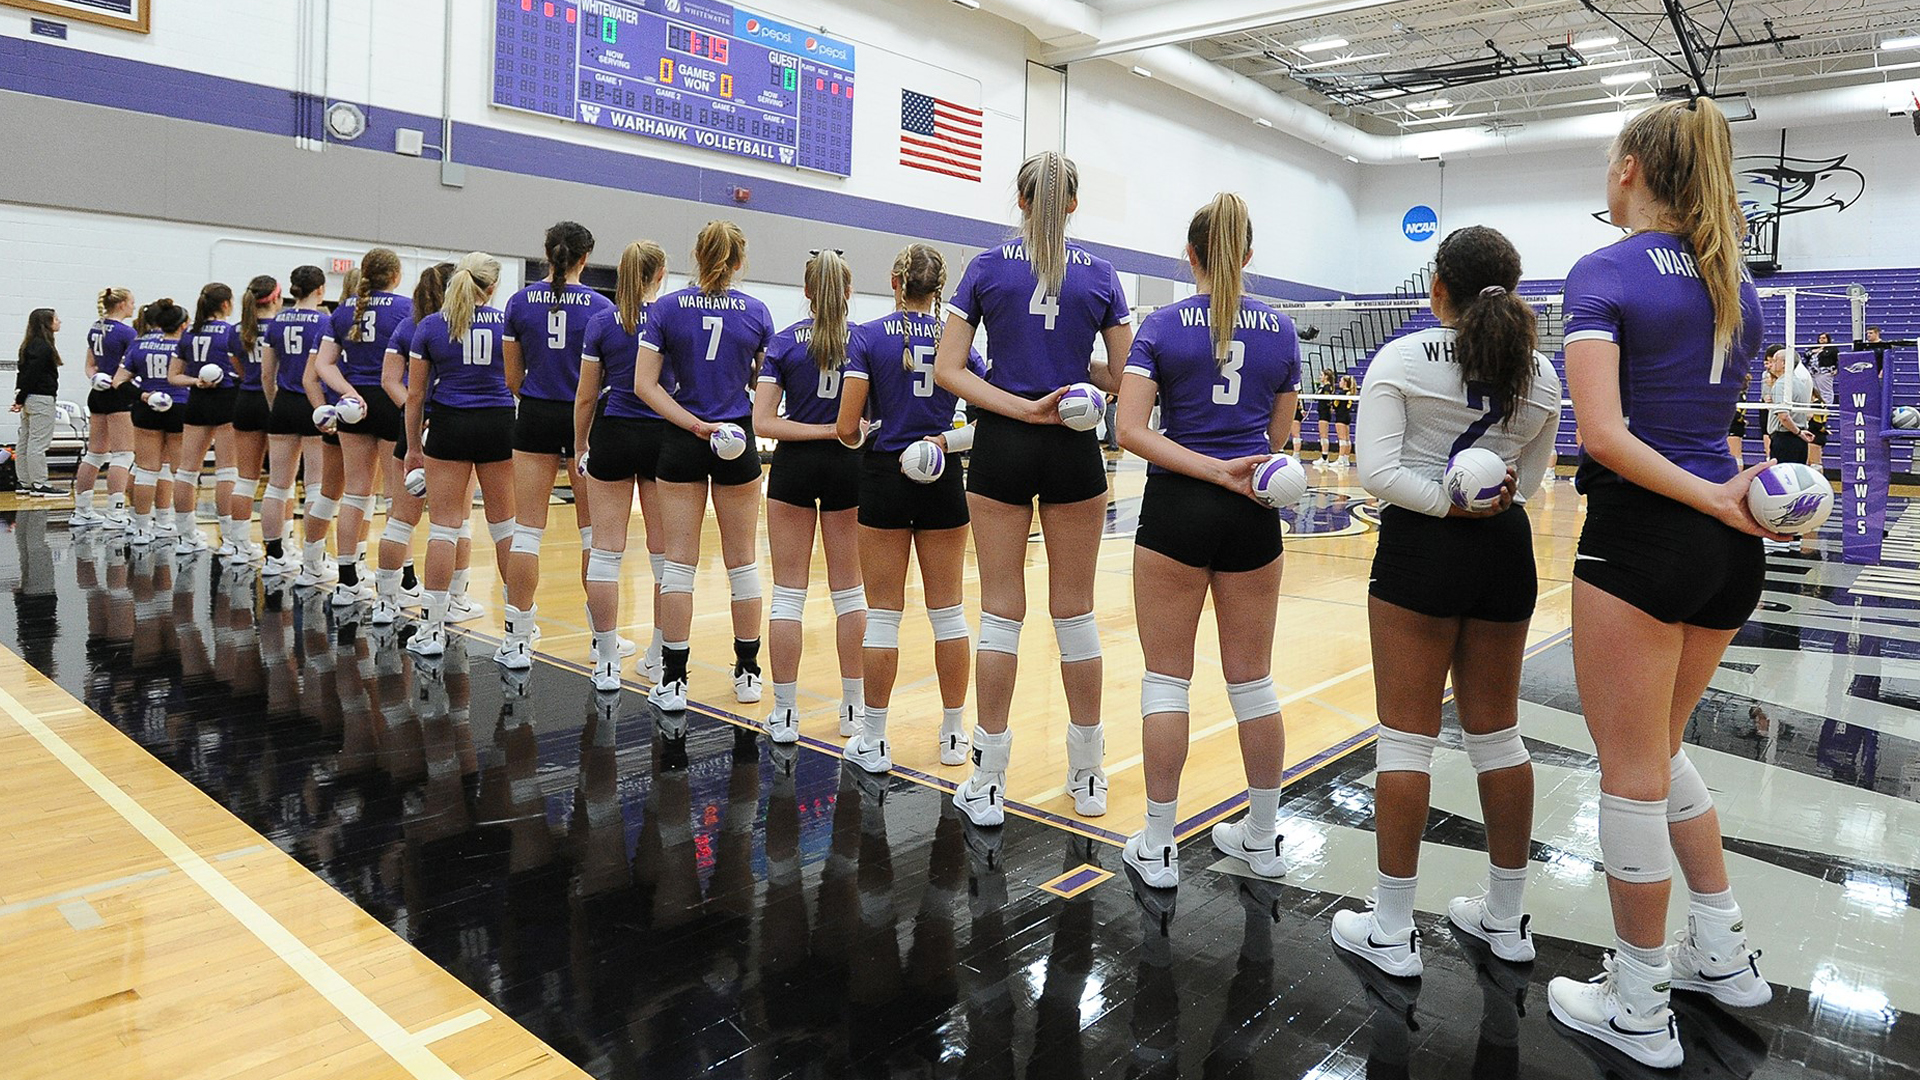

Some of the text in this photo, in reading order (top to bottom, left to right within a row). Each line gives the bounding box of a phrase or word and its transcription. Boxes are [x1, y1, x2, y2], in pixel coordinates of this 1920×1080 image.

[581, 0, 638, 26] WHITEWATER
[683, 6, 730, 25] WHITEWATER
[602, 16, 617, 44] 0
[761, 27, 791, 43] pepsi
[605, 49, 624, 59] NOW
[768, 51, 798, 69] GUEST
[818, 45, 847, 60] pepsi
[598, 55, 631, 70] SERVING
[660, 57, 674, 84] 0
[595, 73, 623, 86] GAME 1
[678, 64, 716, 82] GAMES
[784, 67, 797, 91] 0
[683, 77, 709, 92] WON
[720, 73, 733, 98] 0
[655, 88, 682, 101] GAME 2
[757, 95, 784, 108] SERVING
[763, 89, 779, 99] NOW
[712, 101, 731, 112] GAME
[762, 113, 780, 123] GAME
[610, 111, 775, 159] WARHAWK VOLLEYBALL
[1405, 222, 1436, 234] NCAA
[1003, 244, 1092, 266] WAKS
[332, 259, 353, 273] EXIT
[345, 296, 394, 307] WAAWKS
[678, 295, 746, 311] WARHAWKS
[1029, 275, 1060, 330] 4
[275, 313, 319, 324] WARHAWKS
[1179, 307, 1280, 333] WAAWKS
[548, 310, 567, 350] 9
[703, 317, 723, 361] 7
[139, 341, 177, 351] WARHAWK
[192, 336, 212, 362] 17
[283, 326, 304, 354] 15
[462, 329, 492, 366] 10
[145, 353, 168, 379] 18
[913, 345, 935, 397] 5
[1212, 341, 1246, 406] 3
[1852, 393, 1868, 535] WARHAWKS
